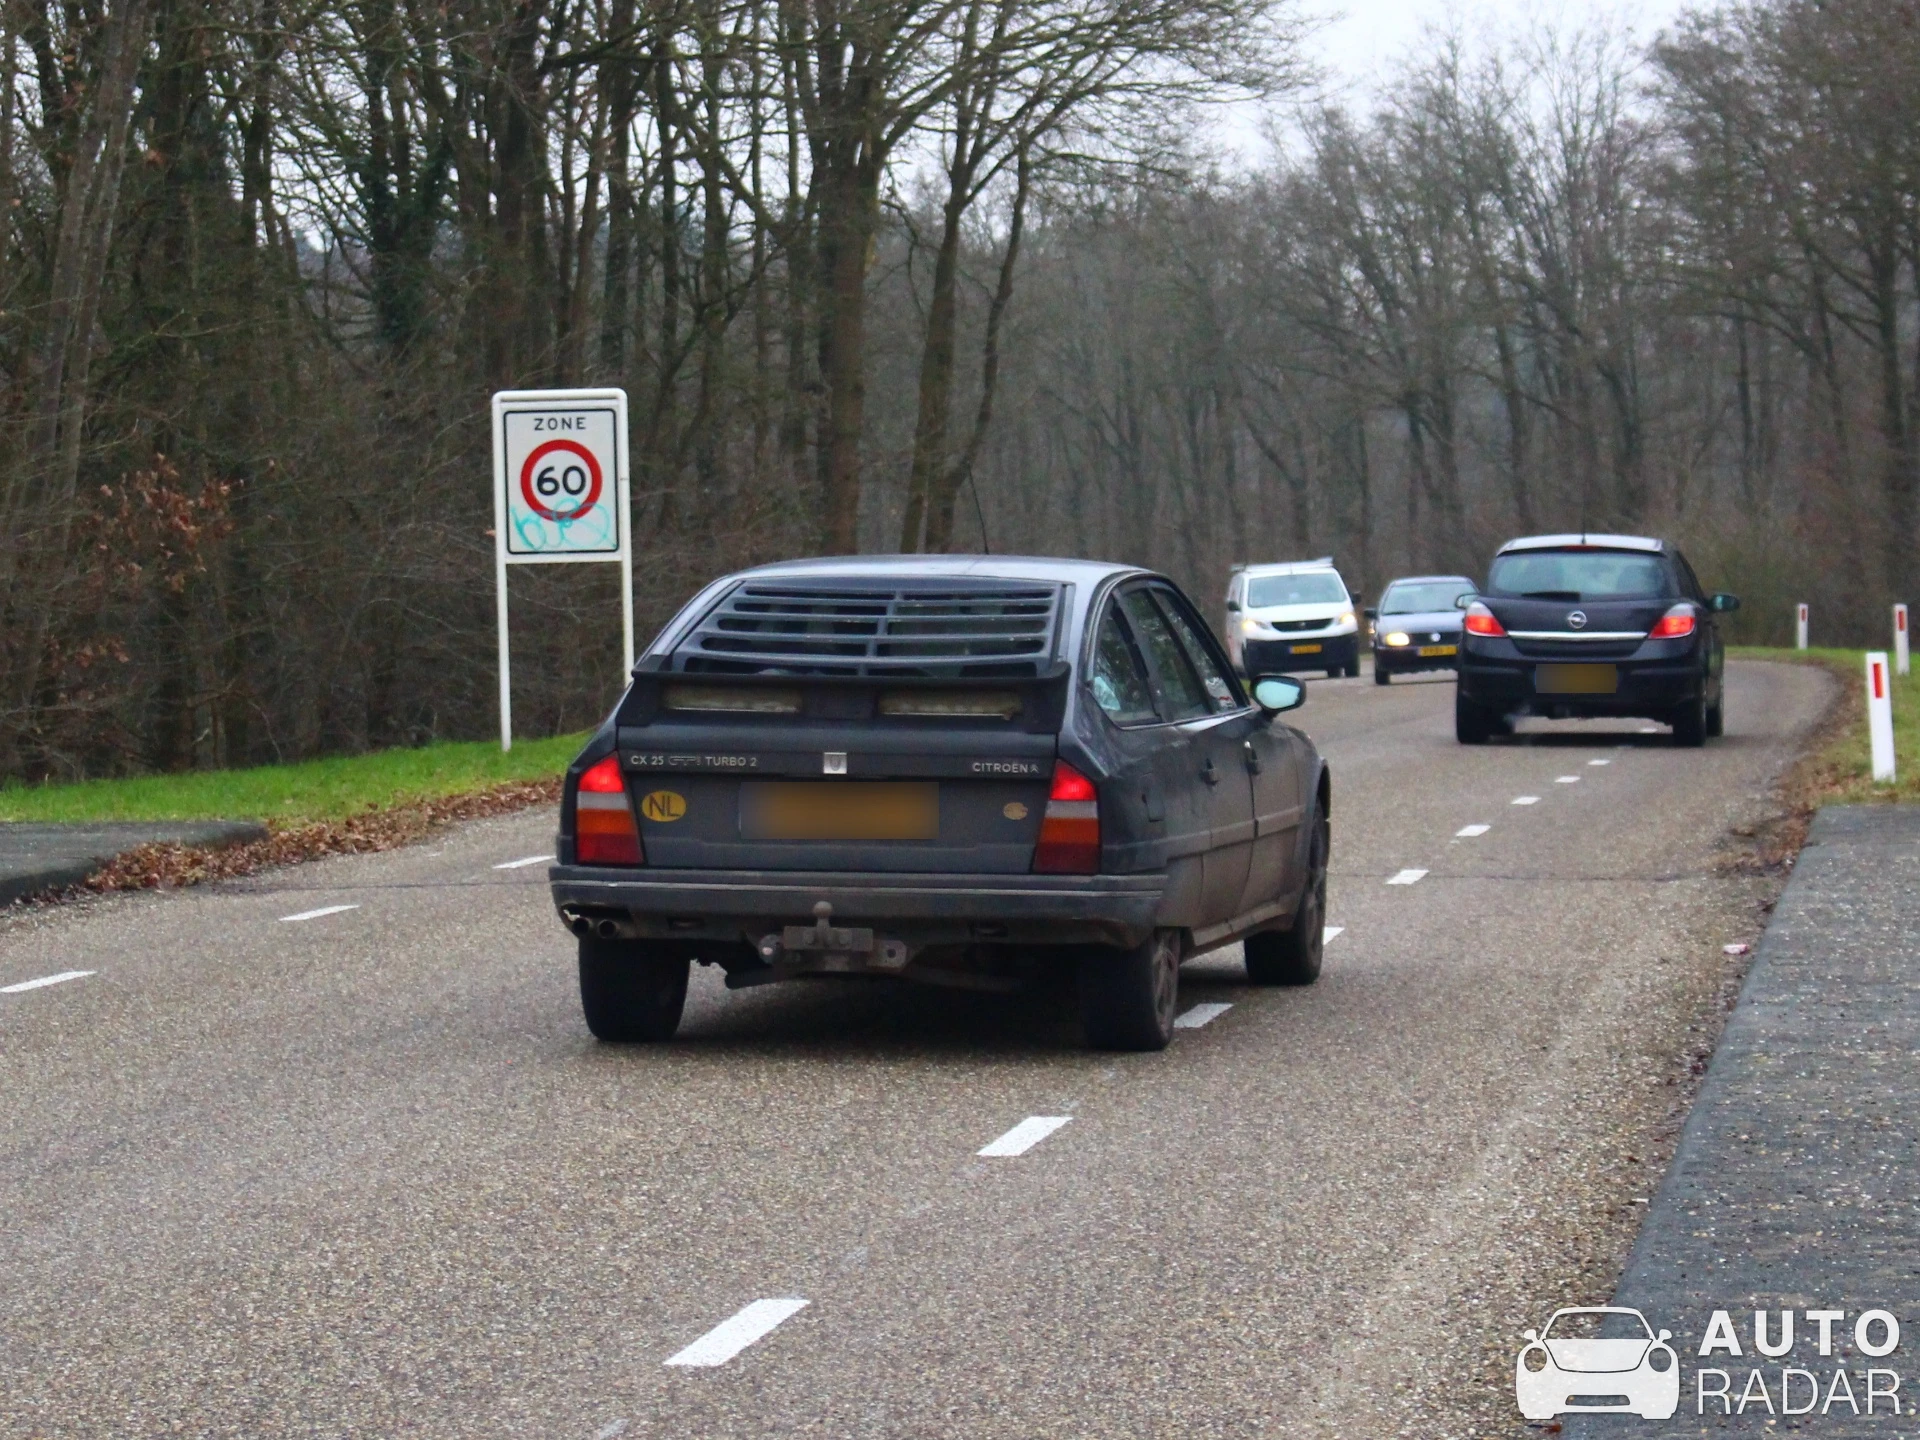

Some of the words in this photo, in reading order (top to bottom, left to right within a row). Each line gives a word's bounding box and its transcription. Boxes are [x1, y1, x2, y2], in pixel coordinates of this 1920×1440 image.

[534, 417, 586, 430] ZONE
[536, 466, 586, 496] 60
[630, 755, 648, 765] CX
[651, 755, 664, 766] 25
[705, 756, 747, 767] TURBO
[749, 757, 758, 767] 2
[649, 794, 681, 817] NL
